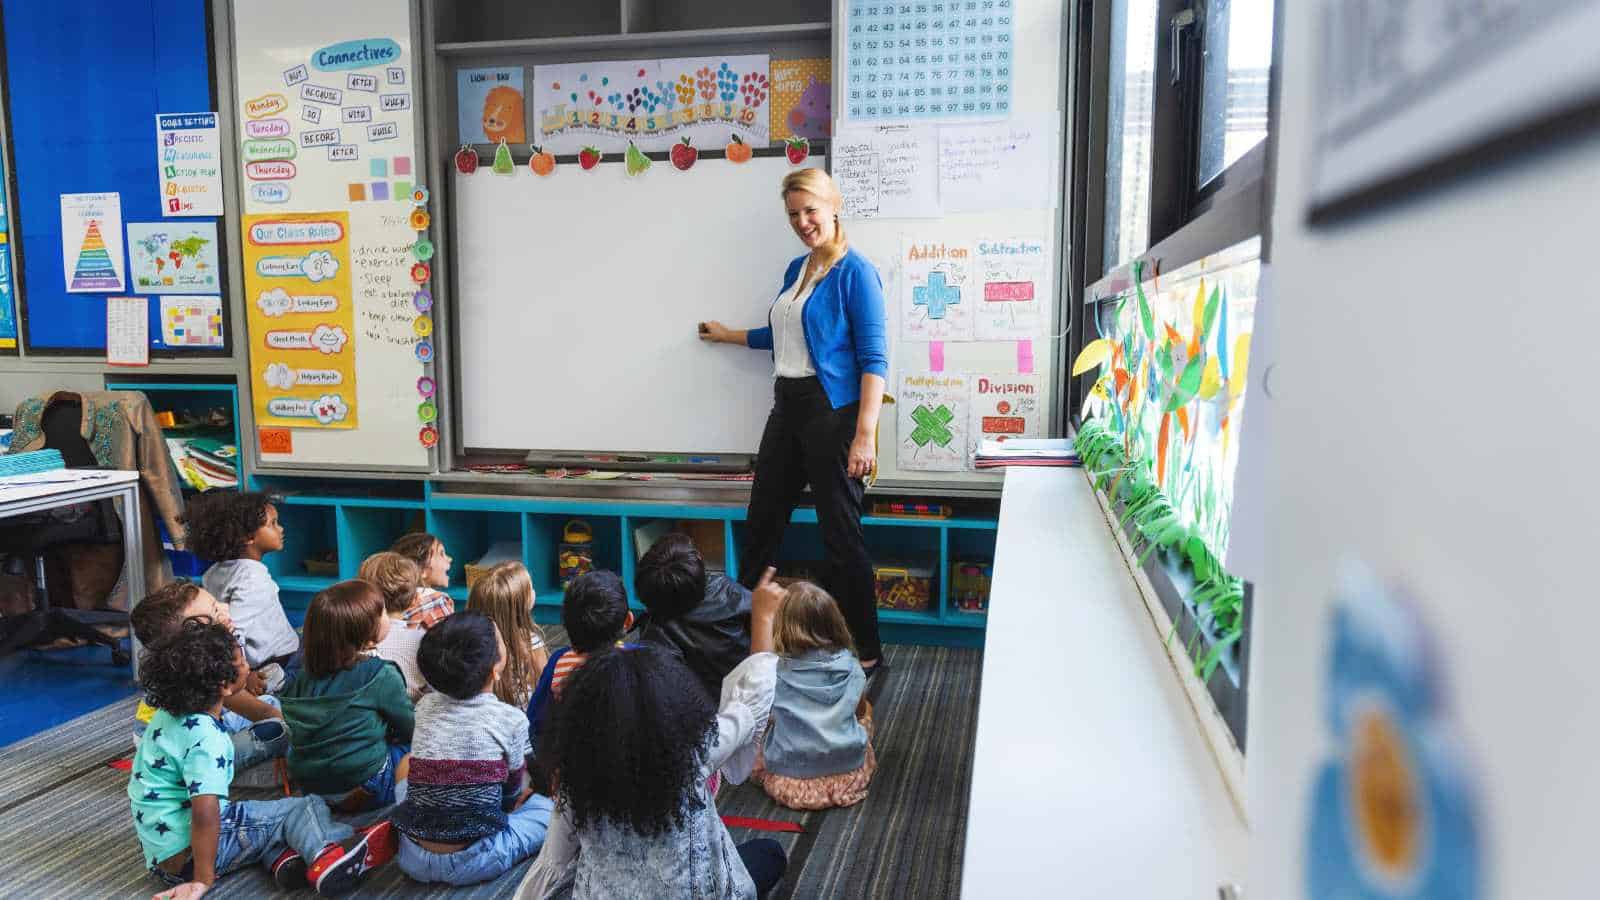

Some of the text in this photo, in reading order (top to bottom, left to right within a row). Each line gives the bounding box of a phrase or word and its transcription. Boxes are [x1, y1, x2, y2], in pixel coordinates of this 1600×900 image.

[900, 6, 910, 14] 34
[916, 5, 926, 13] 35
[966, 2, 976, 10] 38
[983, 0, 992, 8] 39
[867, 24, 878, 32] 42
[883, 40, 894, 48] 53
[900, 40, 910, 48] 54
[916, 38, 926, 46] 55
[932, 38, 942, 46] 56
[949, 36, 960, 44] 57
[998, 34, 1008, 42] 60
[319, 44, 393, 66] Connectives
[899, 56, 910, 64] 64
[915, 56, 926, 64] 65
[998, 51, 1008, 59] 70
[288, 69, 302, 81] BUT
[852, 74, 860, 82] 71
[900, 72, 909, 80] 74
[915, 72, 926, 80] 75
[931, 71, 942, 79] 76
[948, 70, 958, 78] 77
[964, 70, 974, 78] 78
[982, 68, 992, 77] 79
[352, 78, 372, 87] AFTER
[305, 88, 337, 101] BECAUSE
[852, 90, 860, 98] 81
[866, 90, 877, 98] 82
[882, 89, 893, 98] 83
[914, 88, 926, 96] 85
[250, 98, 281, 112] Monday
[384, 98, 405, 107] WHEN
[852, 106, 860, 115] 91
[866, 106, 876, 115] 92
[948, 104, 958, 112] 97
[980, 102, 990, 110] 99
[572, 112, 580, 122] 1
[592, 112, 600, 124] 2
[610, 115, 618, 126] 3
[626, 117, 636, 129] 4
[646, 116, 656, 128] 5
[704, 105, 712, 116] 8
[740, 108, 755, 120] 10
[251, 124, 284, 134] Tuesday
[304, 132, 336, 144] BEFORE
[332, 148, 354, 156] AFTER
[255, 163, 290, 174] Thursday
[258, 188, 283, 199] Friday
[256, 225, 338, 240] Our Class Rules
[359, 246, 389, 255] drink
[909, 242, 968, 260] Addition
[979, 242, 1041, 256] Subtraction
[978, 378, 1034, 394] Division
